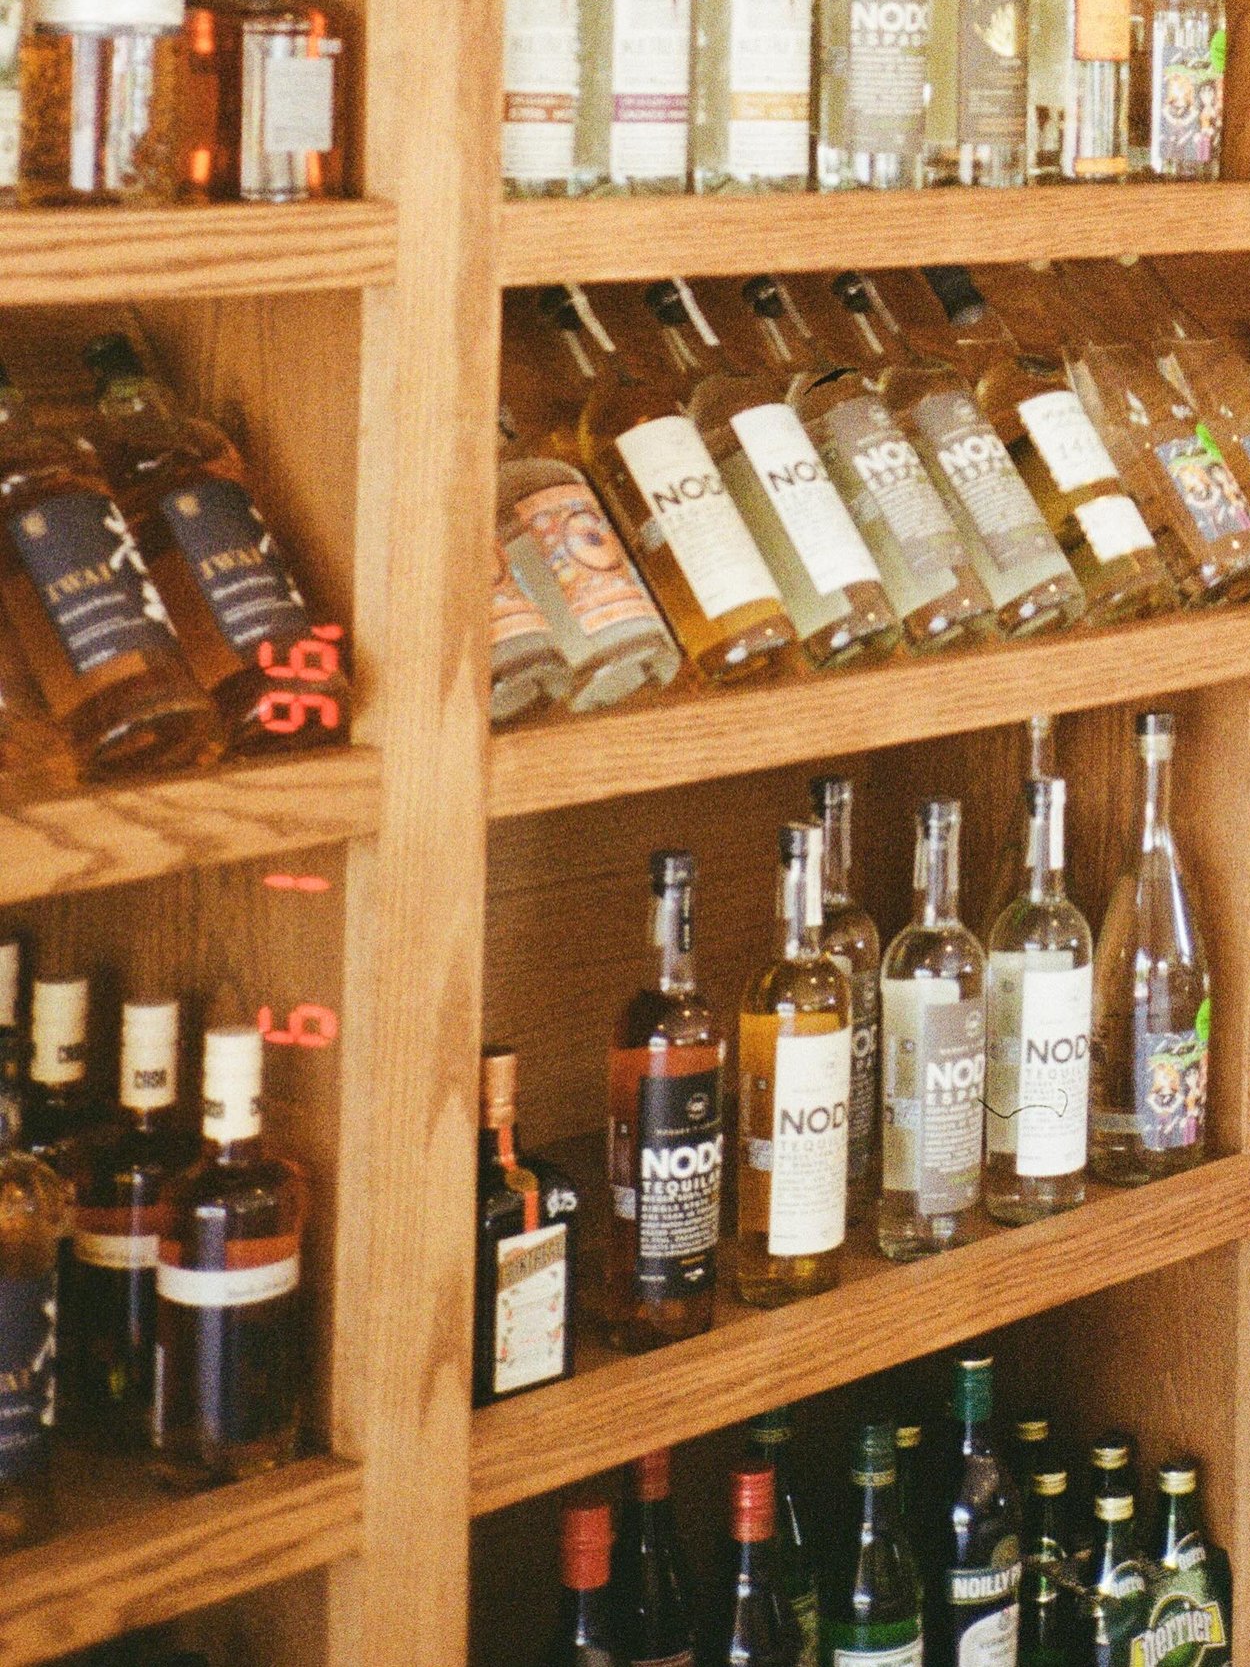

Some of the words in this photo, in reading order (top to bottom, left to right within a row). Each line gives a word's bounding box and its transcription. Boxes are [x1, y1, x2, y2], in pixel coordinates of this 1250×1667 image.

[767, 460, 829, 492] NO
[1025, 1034, 1091, 1065] NOD
[778, 1101, 849, 1136] NOD
[952, 1570, 1007, 1600] NOILLY
